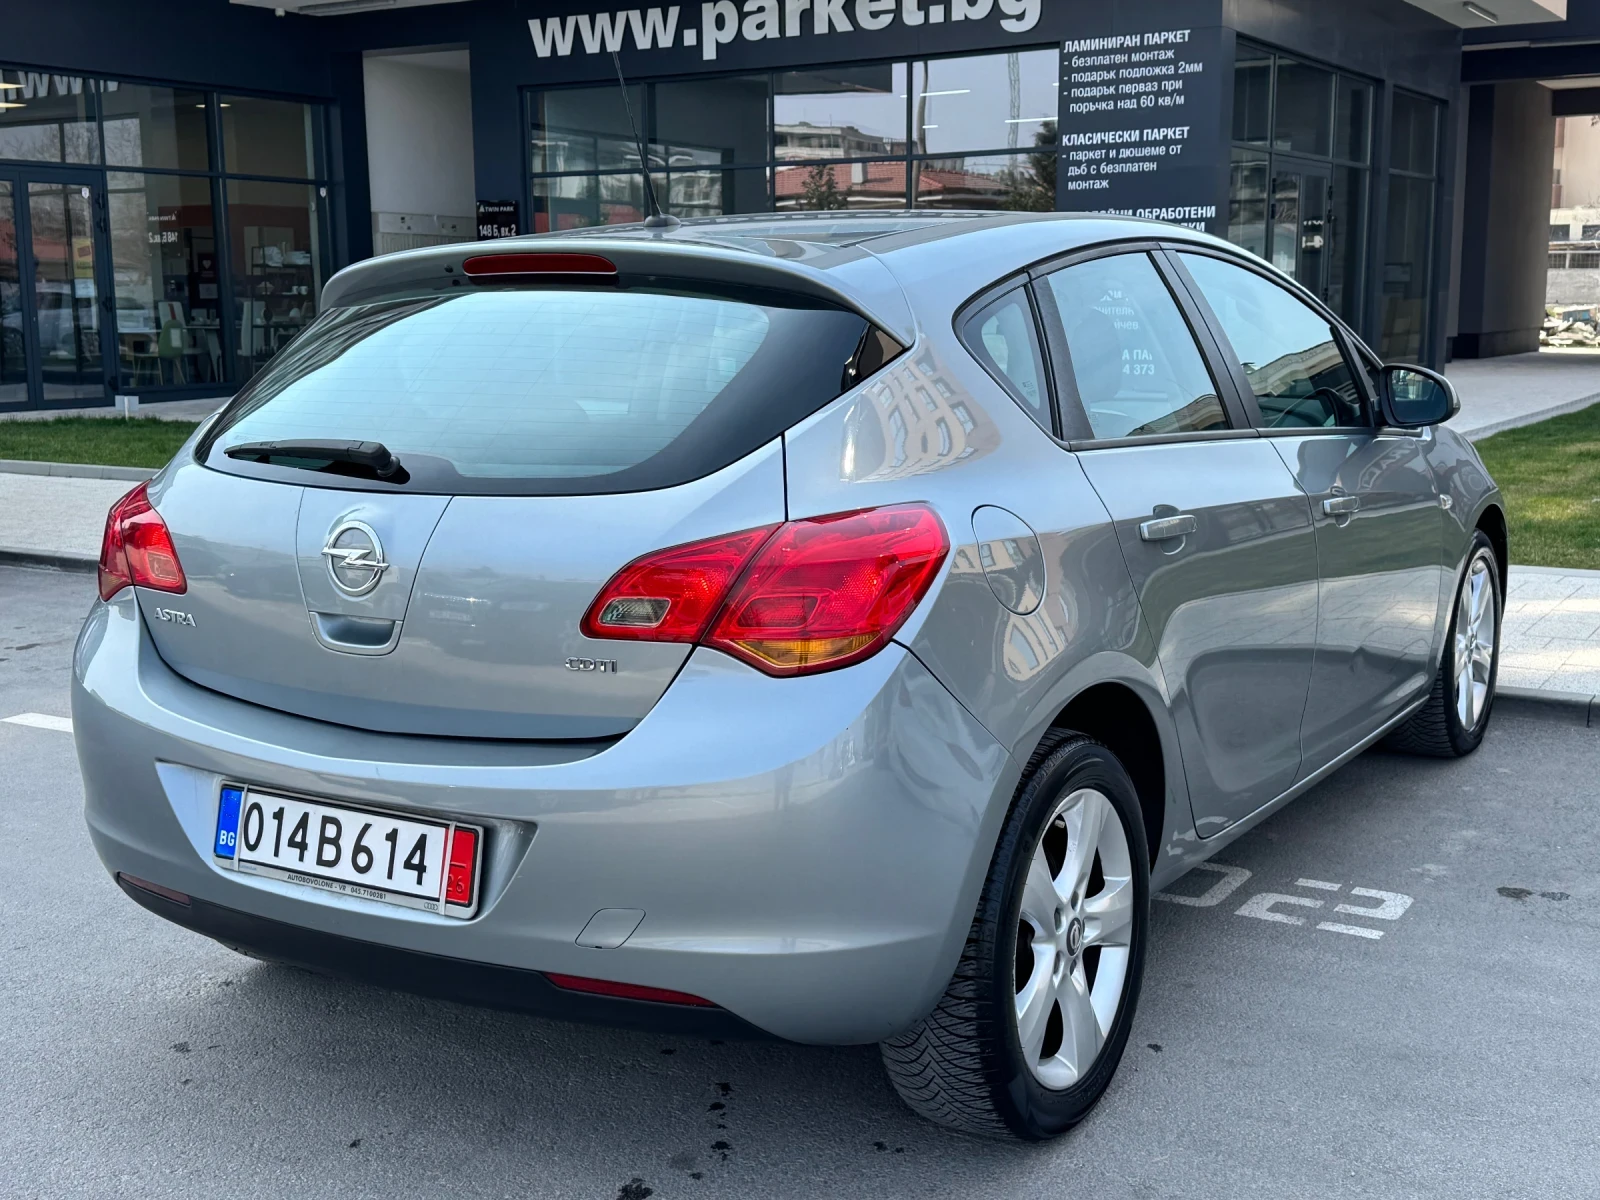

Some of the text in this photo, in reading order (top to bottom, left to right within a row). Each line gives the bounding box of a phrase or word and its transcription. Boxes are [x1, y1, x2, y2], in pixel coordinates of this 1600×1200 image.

[1064, 29, 1191, 53] ЛАМИНИРАН ПАРКЕТ
[1072, 53, 1128, 68] безплатен
[1131, 49, 1175, 62] монтаж
[1119, 64, 1174, 79] подложка
[1178, 61, 1203, 74] 2мм
[1119, 81, 1158, 95] перваз
[1161, 80, 1183, 92] при
[1117, 98, 1137, 109] над
[1140, 95, 1155, 107] 60
[1158, 93, 1185, 107] кв/м
[1062, 126, 1190, 147] КЛАСИЧЕСКИ ПАРКЕТ
[1069, 148, 1106, 162] паркет
[1109, 149, 1116, 159] и
[1119, 145, 1165, 159] дюшеме
[1169, 144, 1182, 155] от
[1090, 164, 1097, 175] с
[1100, 160, 1157, 174] безплатен
[1068, 178, 1109, 190] монтаж
[479, 224, 492, 237] 148
[1133, 363, 1155, 375] 373
[154, 607, 197, 628] ASTRA
[565, 656, 617, 674] CDTI
[219, 830, 236, 847] BG
[243, 801, 428, 886] 014B614
[287, 873, 333, 889] AUTOBOVOLONE
[339, 884, 347, 892] VR
